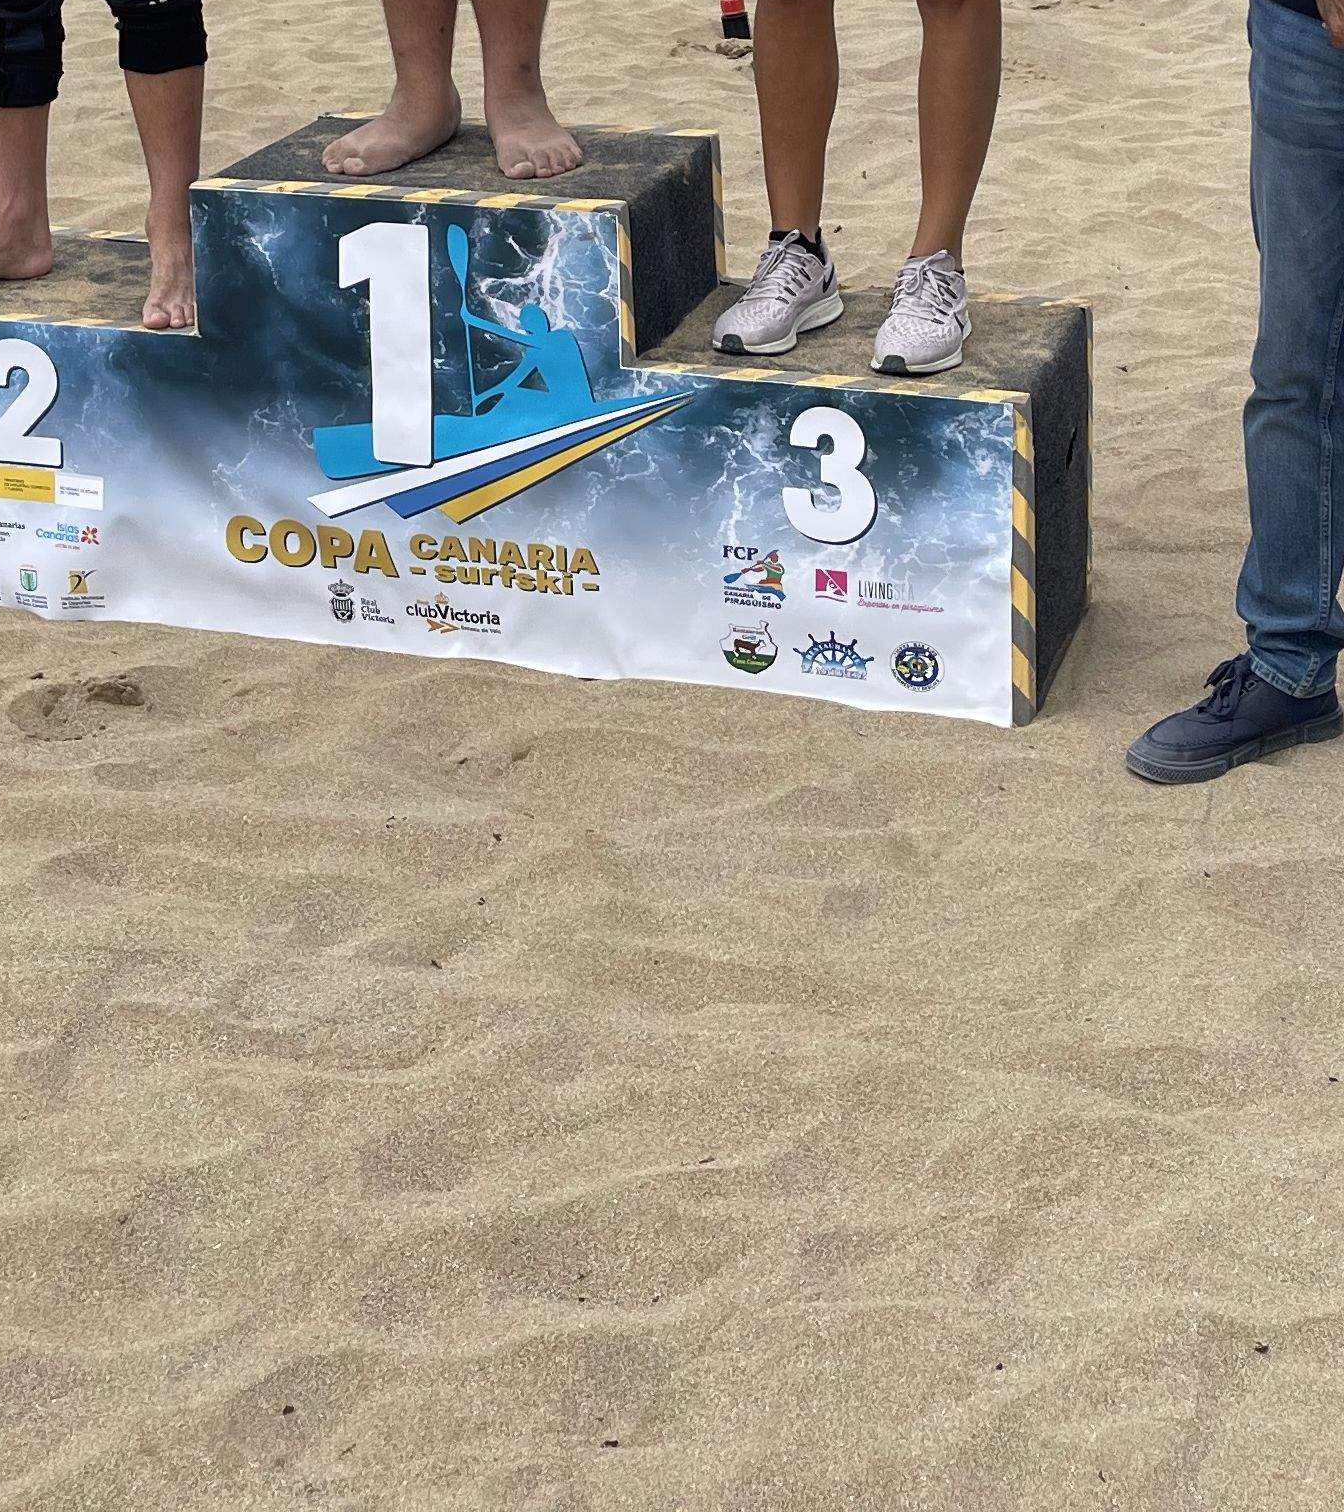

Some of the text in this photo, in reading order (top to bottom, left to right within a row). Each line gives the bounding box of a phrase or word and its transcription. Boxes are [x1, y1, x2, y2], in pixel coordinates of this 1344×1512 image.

[338, 221, 434, 468] 1
[782, 406, 878, 545] 3
[225, 514, 601, 579] COPA CANARIA
[723, 544, 759, 561] FCP
[361, 597, 377, 607] Real
[361, 604, 381, 615] Club
[361, 612, 396, 625] Victoria
